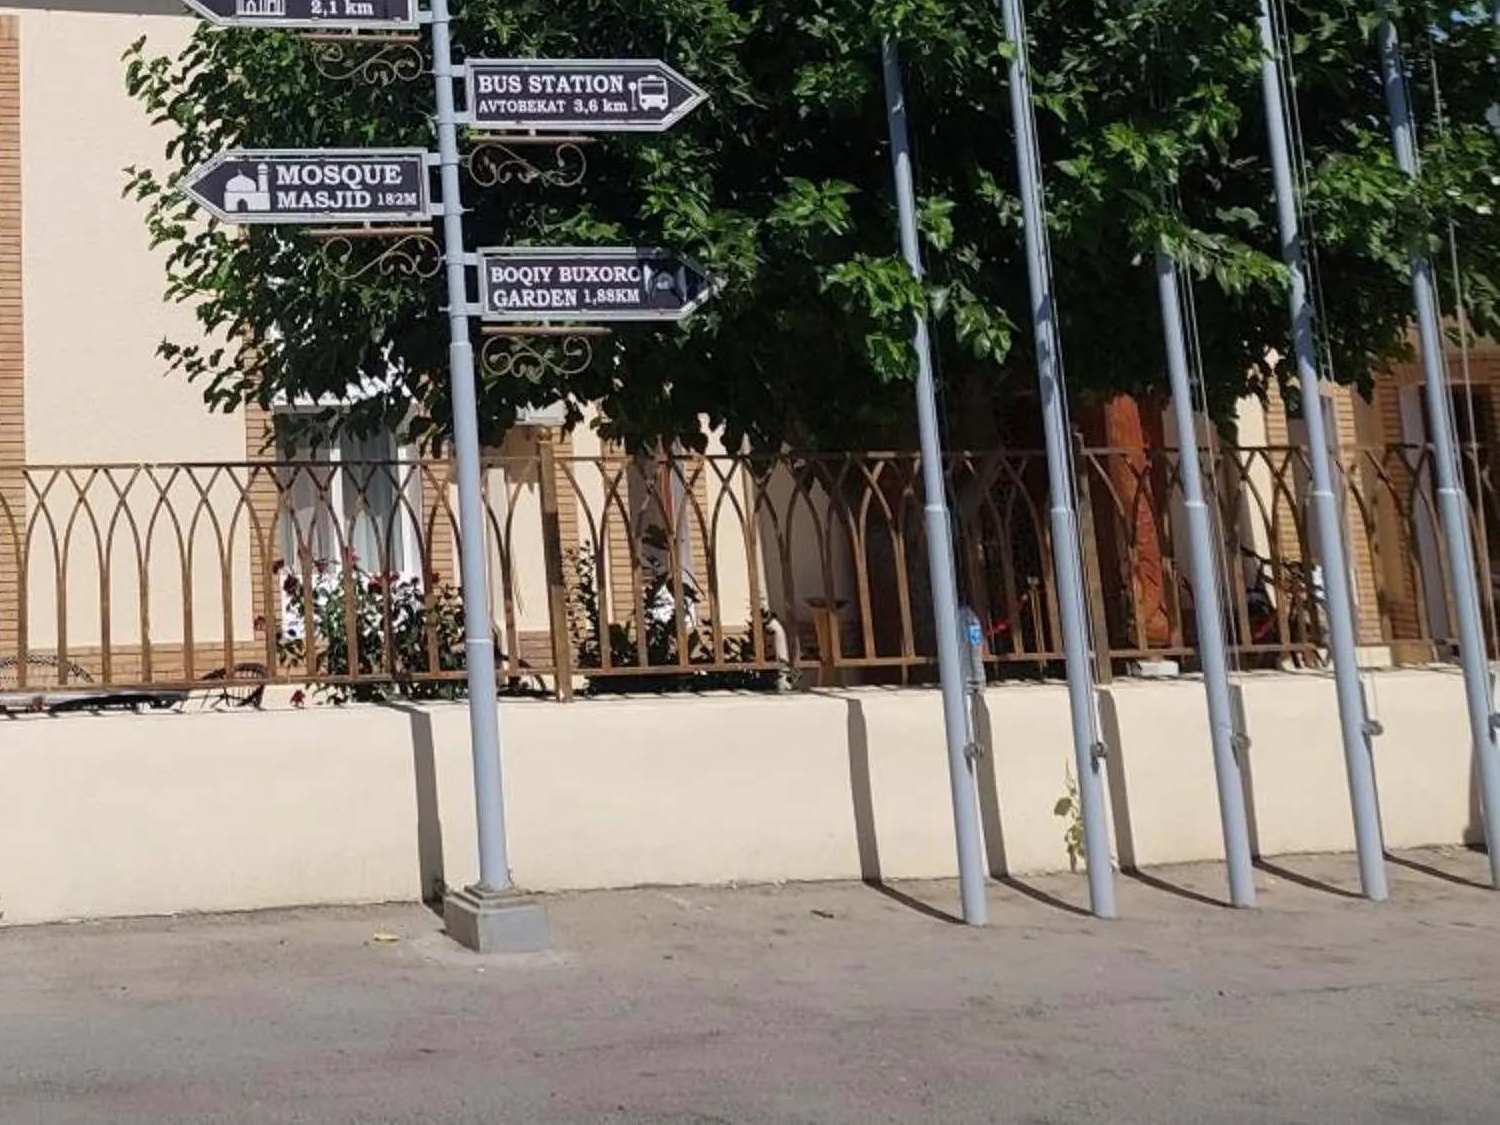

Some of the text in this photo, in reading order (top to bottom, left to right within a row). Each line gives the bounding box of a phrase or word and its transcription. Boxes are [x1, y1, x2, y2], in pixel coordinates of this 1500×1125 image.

[311, 0, 374, 16] 2,1 km
[478, 75, 624, 94] BUS STATION
[478, 98, 629, 115] AVTOBEKAT 3,6 km
[275, 164, 403, 189] MOSQUE
[276, 191, 372, 208] MASJID
[490, 266, 553, 286] BOQIY
[493, 288, 578, 308] GARDEN
